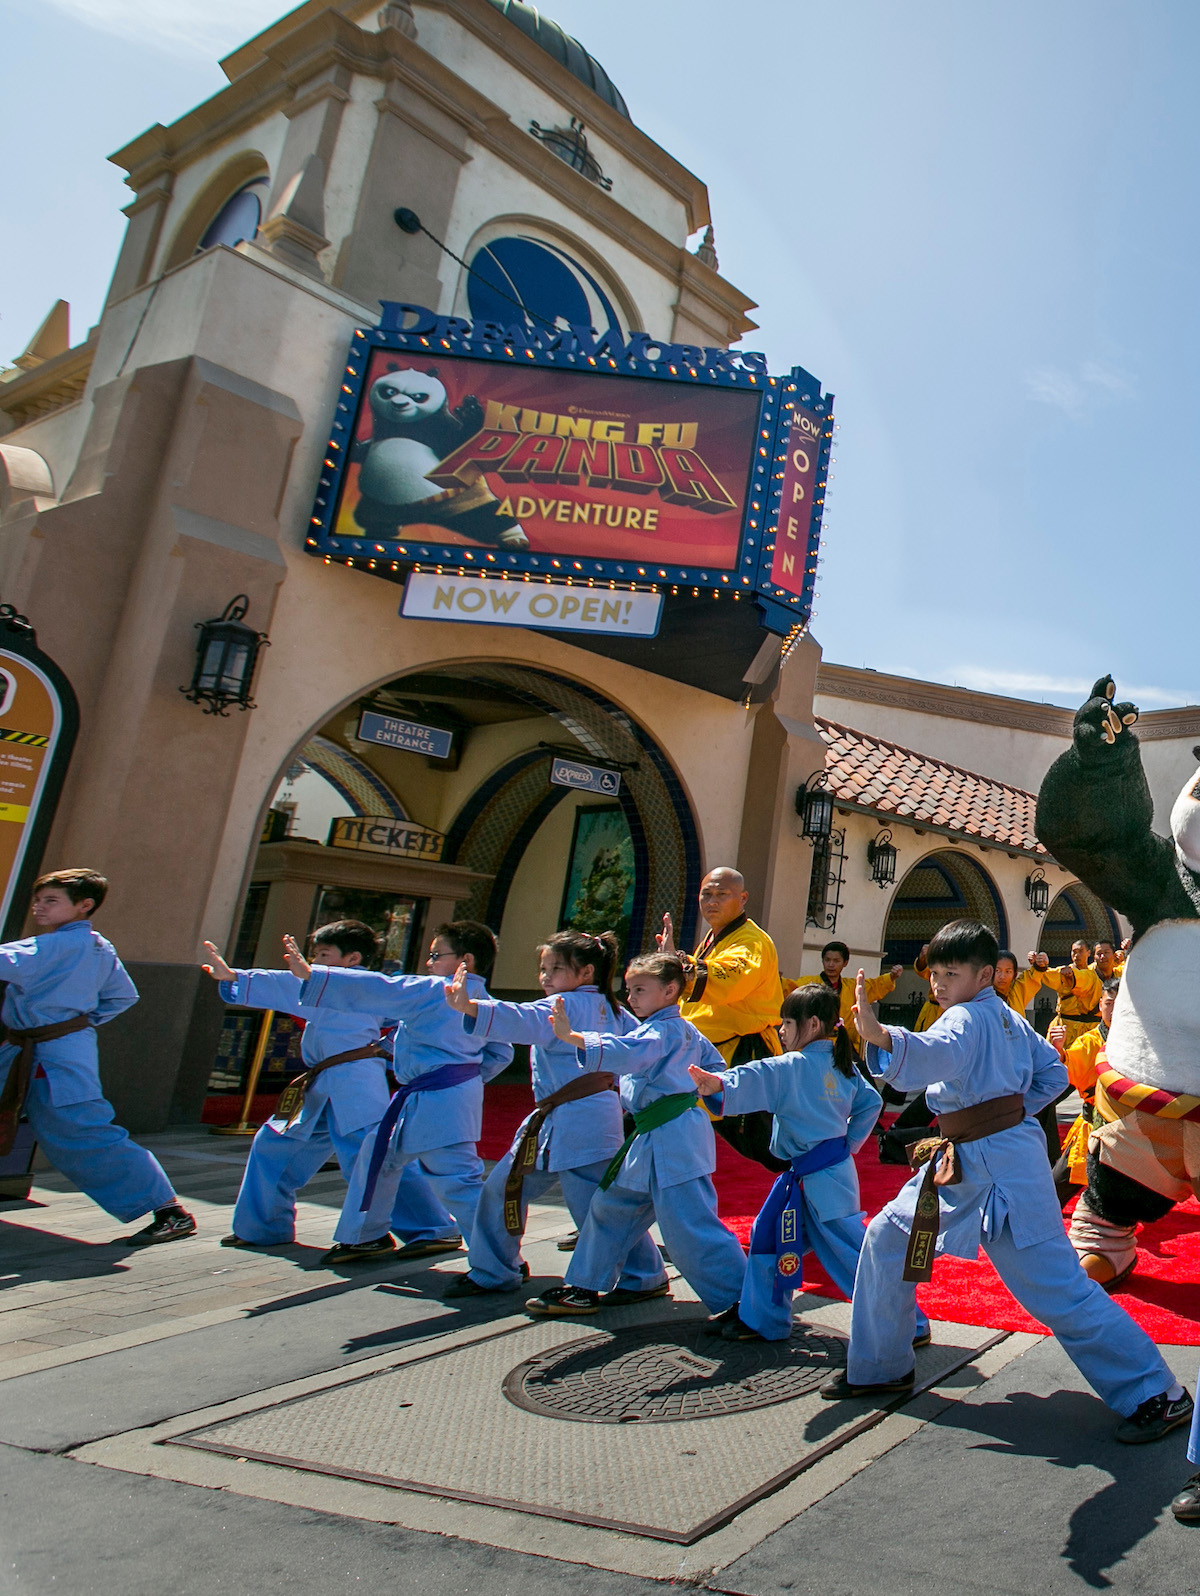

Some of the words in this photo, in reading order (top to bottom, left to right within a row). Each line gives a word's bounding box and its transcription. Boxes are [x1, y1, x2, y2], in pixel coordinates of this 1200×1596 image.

[484, 400, 625, 442] KUNG
[637, 422, 699, 449] FU
[793, 411, 820, 437] NOW
[424, 427, 738, 512] PANDA
[495, 496, 659, 531] ADVENTURE
[781, 449, 810, 577] OPEN
[433, 585, 521, 615] NOW
[528, 593, 633, 625] OPEN!
[376, 730, 435, 752] ENTRANCE
[384, 719, 432, 740] THEATRE
[559, 767, 591, 782] EXPRESS
[343, 820, 441, 854] TICKETS
